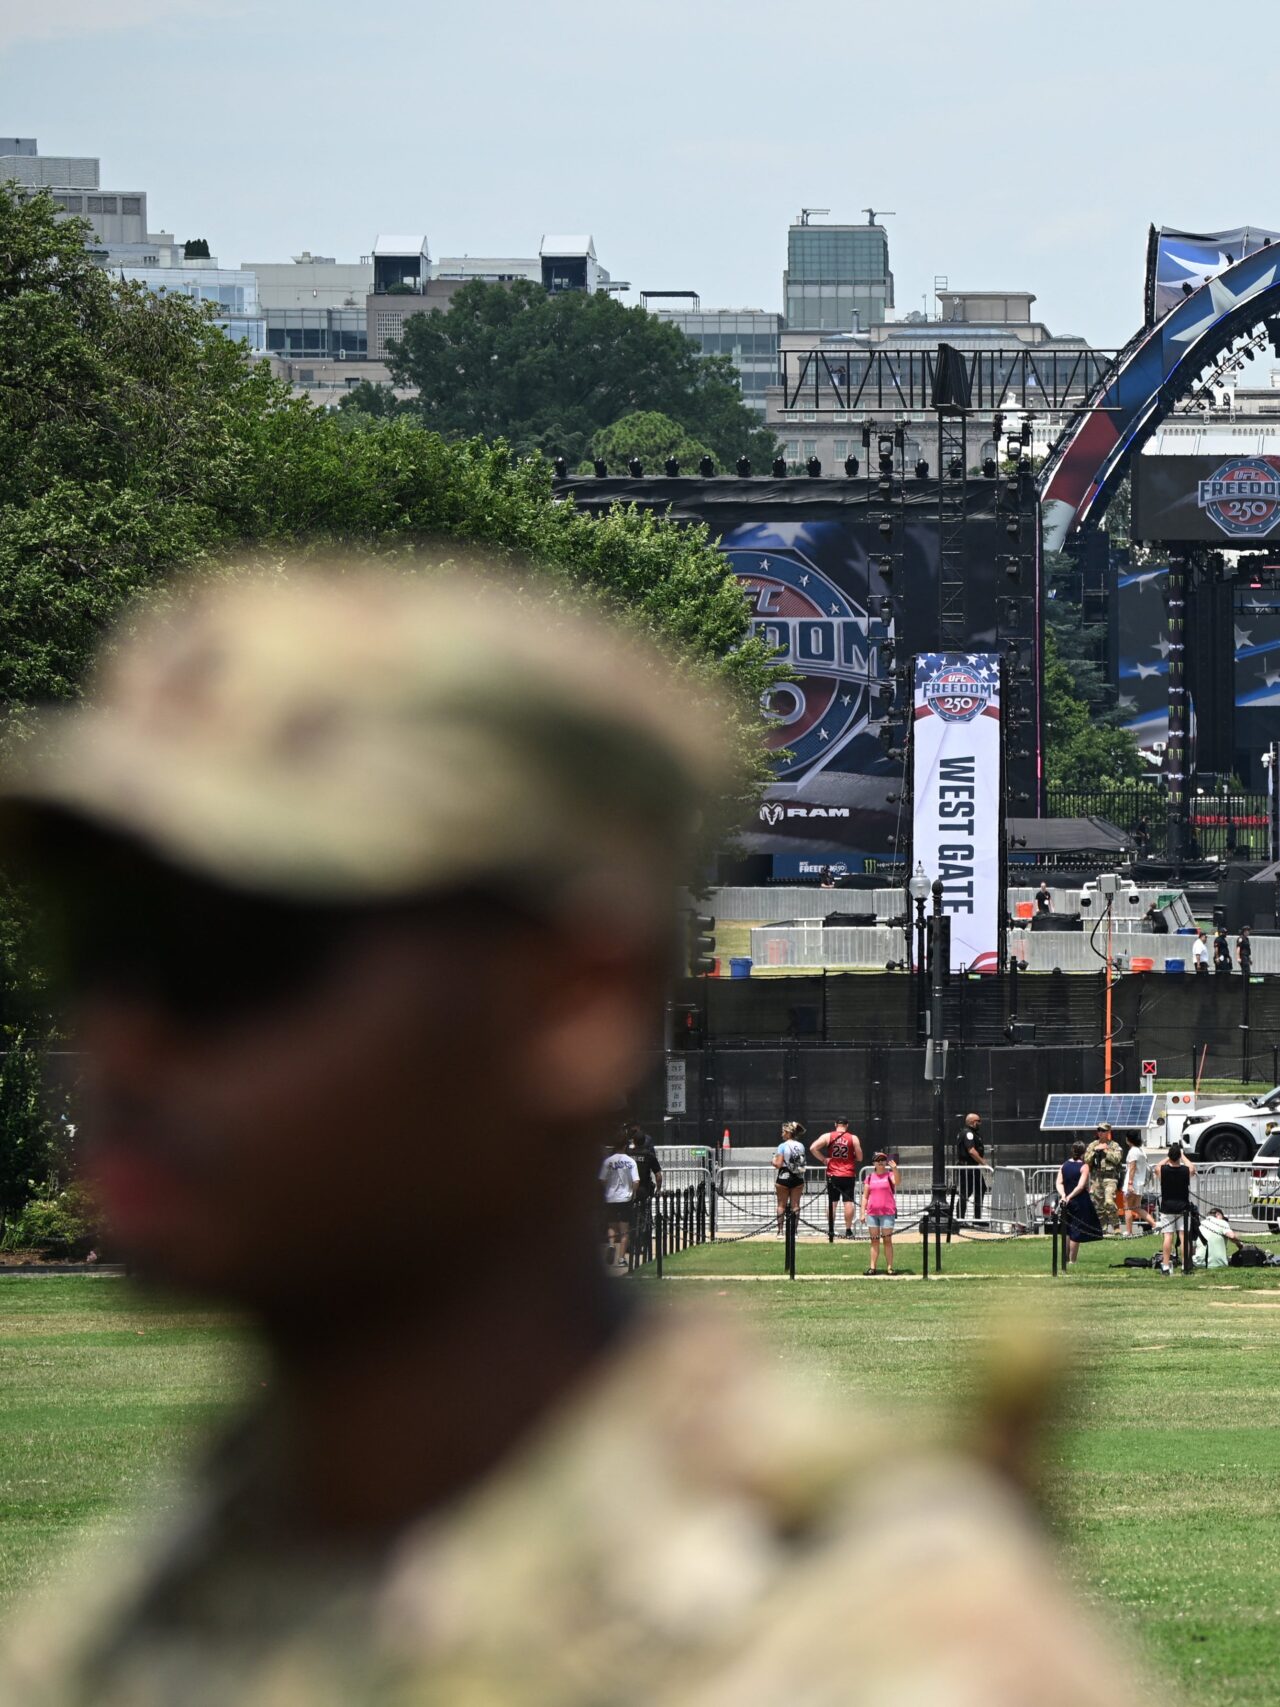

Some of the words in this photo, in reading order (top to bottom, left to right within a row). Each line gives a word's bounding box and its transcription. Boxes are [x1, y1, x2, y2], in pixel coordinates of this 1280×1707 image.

[1234, 470, 1260, 480] UFC
[1228, 501, 1267, 521] 250
[923, 683, 992, 698] FREEDOM
[944, 697, 973, 712] 250
[938, 756, 975, 836] WEST
[787, 808, 850, 818] RAM
[938, 844, 975, 914] GATE
[832, 1145, 849, 1159] 22
